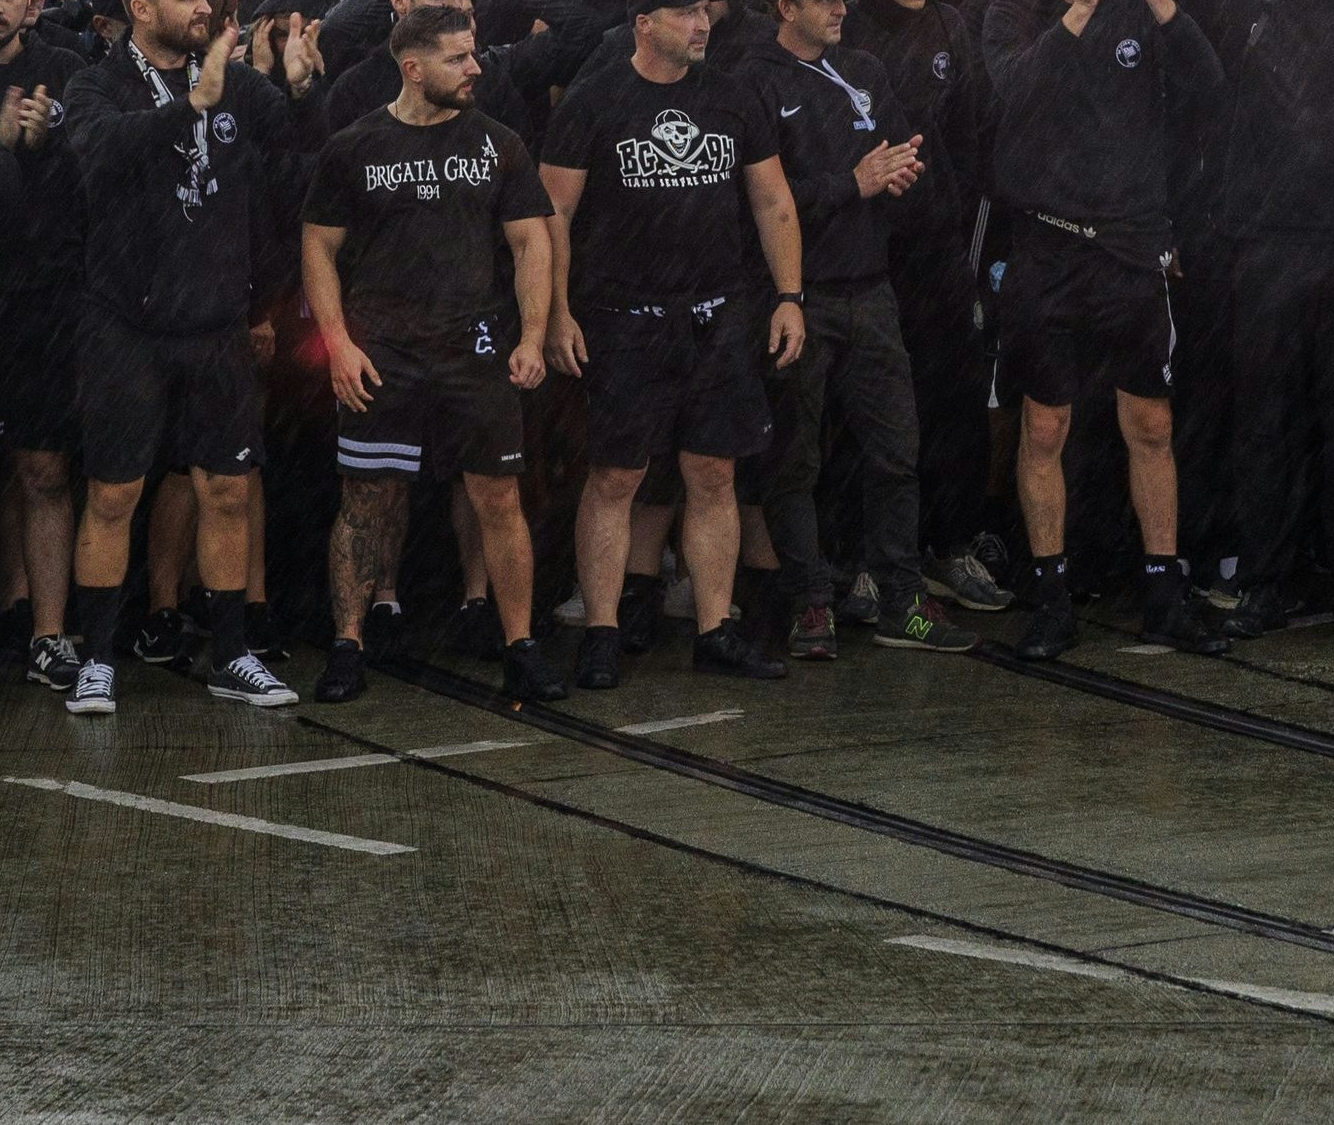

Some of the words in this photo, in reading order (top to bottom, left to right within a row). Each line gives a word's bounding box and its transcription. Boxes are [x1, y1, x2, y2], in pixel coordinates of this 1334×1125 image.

[616, 138, 659, 177] BG
[704, 134, 735, 171] 94
[365, 159, 438, 192] BRIGATA
[444, 154, 491, 187] GRAZ
[660, 176, 699, 188] SEMPRE
[417, 184, 440, 201] 1994
